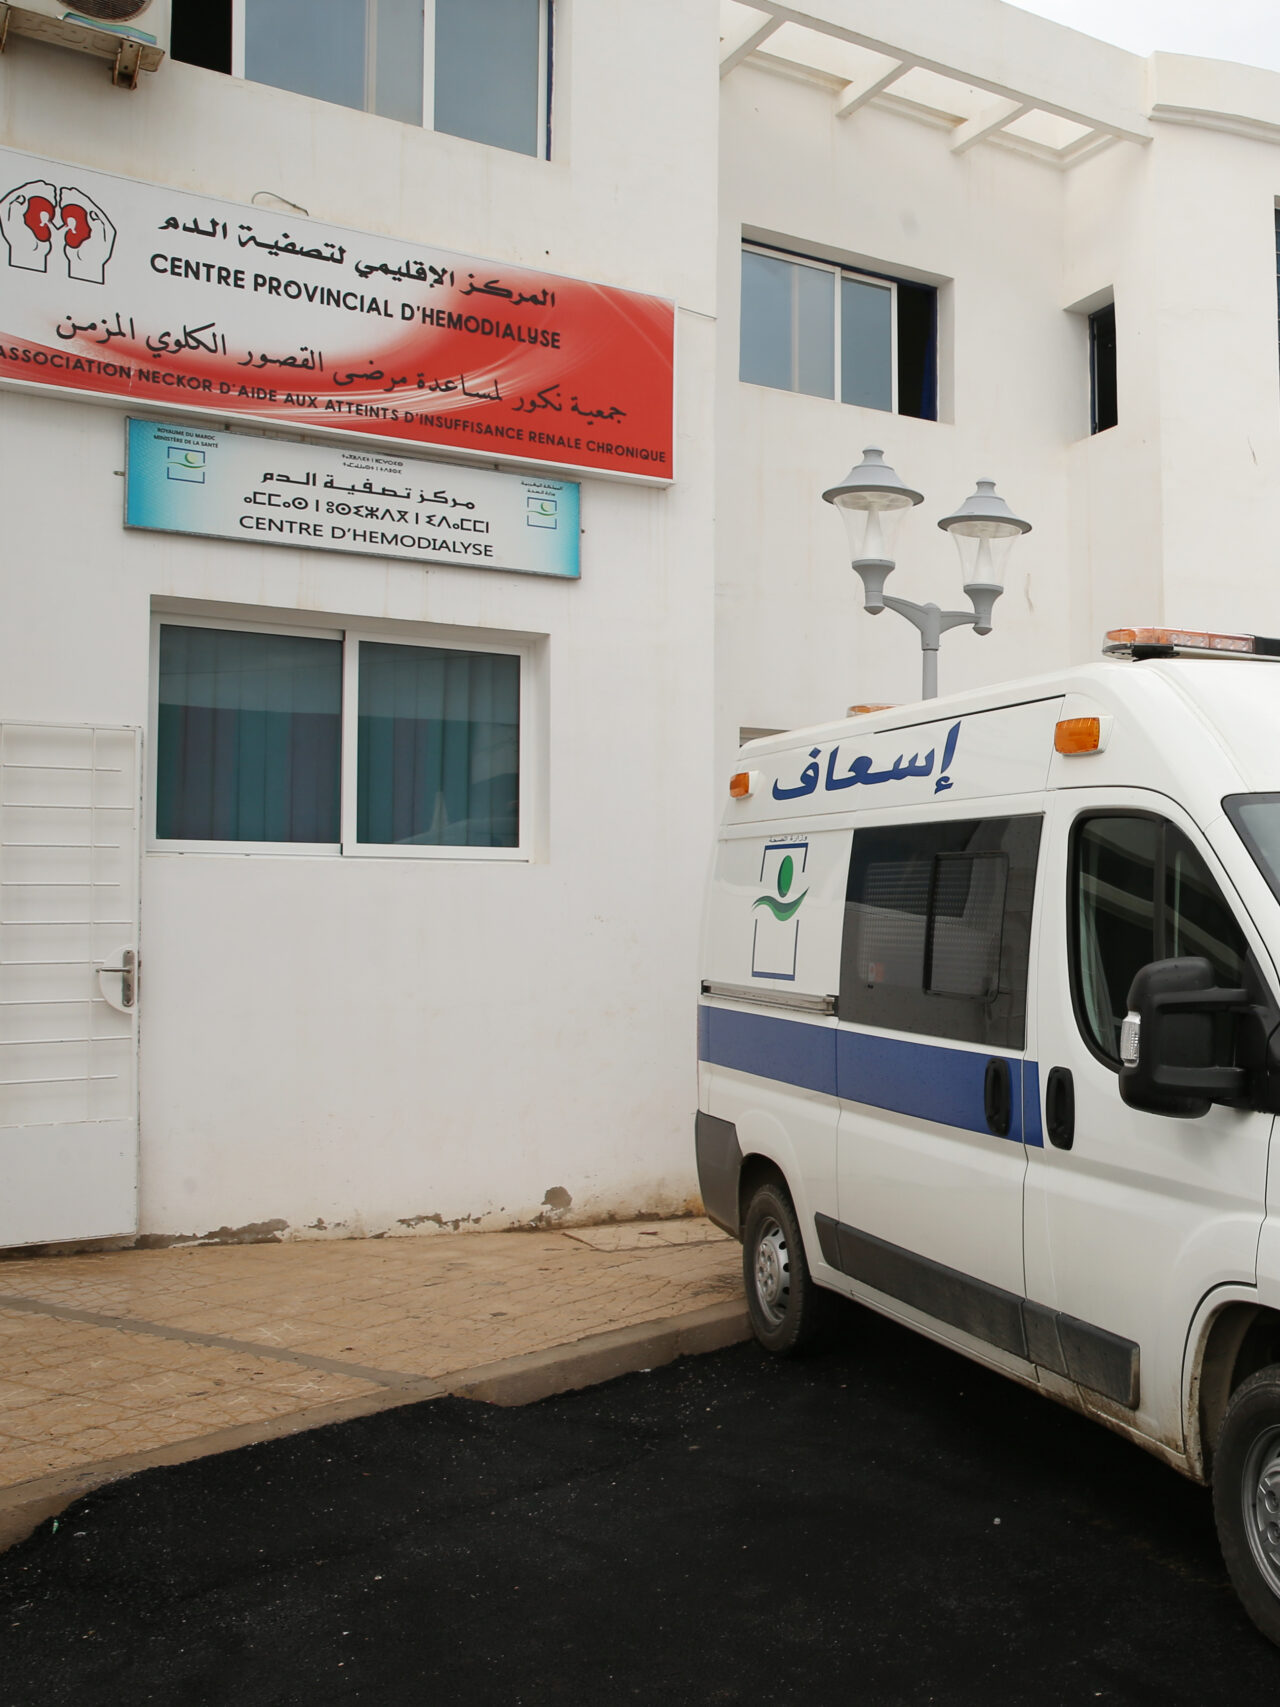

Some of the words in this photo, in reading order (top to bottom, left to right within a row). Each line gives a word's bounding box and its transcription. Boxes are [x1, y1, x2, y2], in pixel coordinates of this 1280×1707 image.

[158, 216, 228, 240] الدم
[238, 224, 347, 265] لتصفية
[150, 253, 246, 289] CENTRE
[253, 273, 394, 318] PROVINCIAL
[401, 302, 561, 350] D'HEMODIALYSE
[459, 273, 555, 307] المركز
[56, 312, 135, 344] المزمن
[146, 323, 227, 359] الكلوي
[237, 346, 324, 372] القصور
[333, 360, 408, 392] مرضى
[417, 373, 502, 402] لمساعدة
[512, 384, 562, 413] نكور
[570, 396, 627, 426] جمعية
[138, 368, 212, 392] NECKOR
[219, 382, 277, 402] D'AIDE
[283, 392, 318, 409] AUX
[325, 399, 399, 421] ATTEINTS
[404, 411, 524, 441] D'INSUFFISANCE
[528, 430, 581, 450] RENALE
[586, 440, 666, 463] CHRONIQUE
[157, 427, 184, 436] ROYAUME
[195, 432, 216, 440] MAROC
[261, 472, 317, 486] الدم
[323, 474, 411, 499] تصفية
[417, 489, 476, 510] مركز
[239, 515, 324, 537] CENTRE
[331, 525, 494, 557] D'HEMODIALYSE
[772, 720, 961, 800] إسعاف
